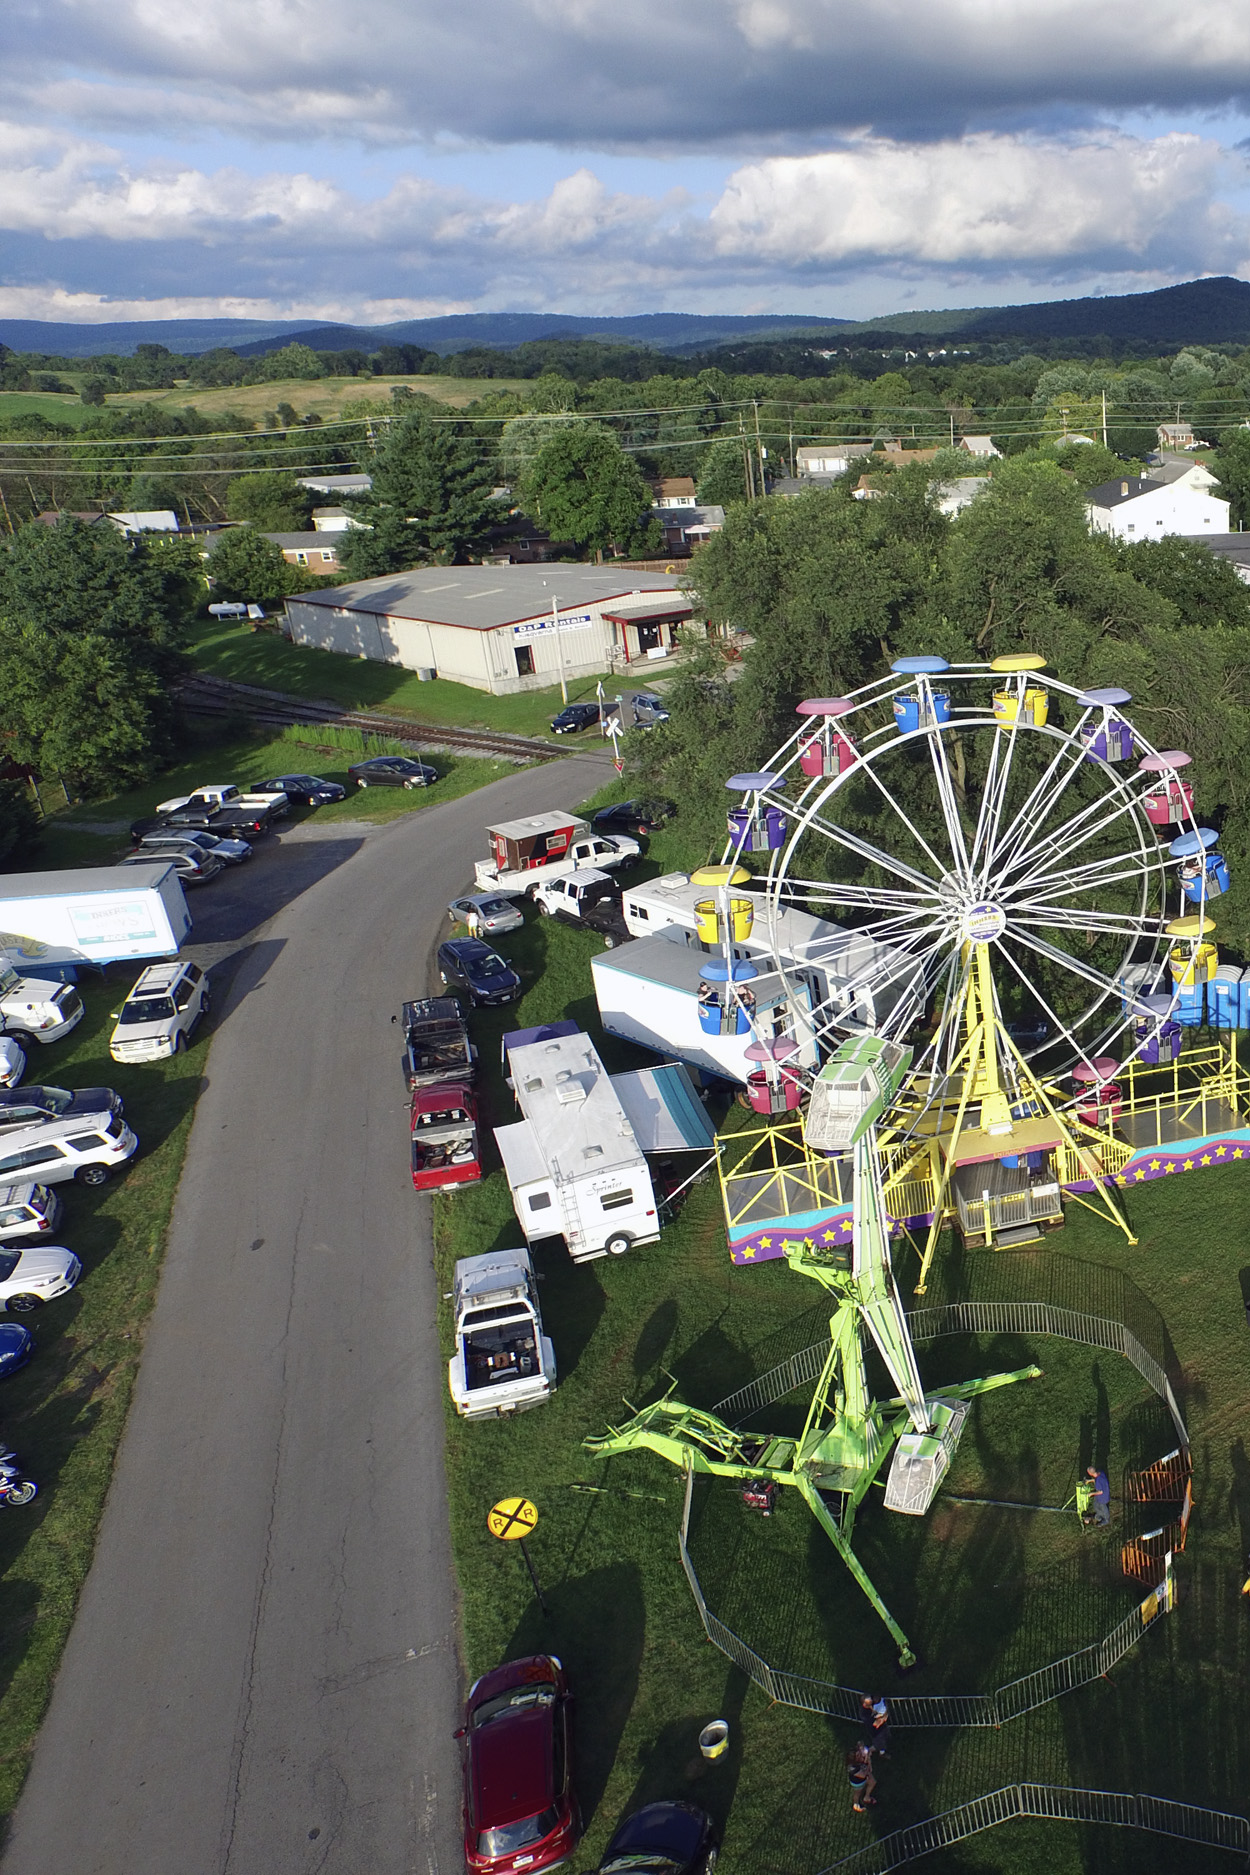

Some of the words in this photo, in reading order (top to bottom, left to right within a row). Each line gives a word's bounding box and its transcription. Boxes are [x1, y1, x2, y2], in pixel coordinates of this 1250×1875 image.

[586, 1181, 622, 1196] Sprinter
[492, 1518, 503, 1529] R
[523, 1508, 534, 1519] R
